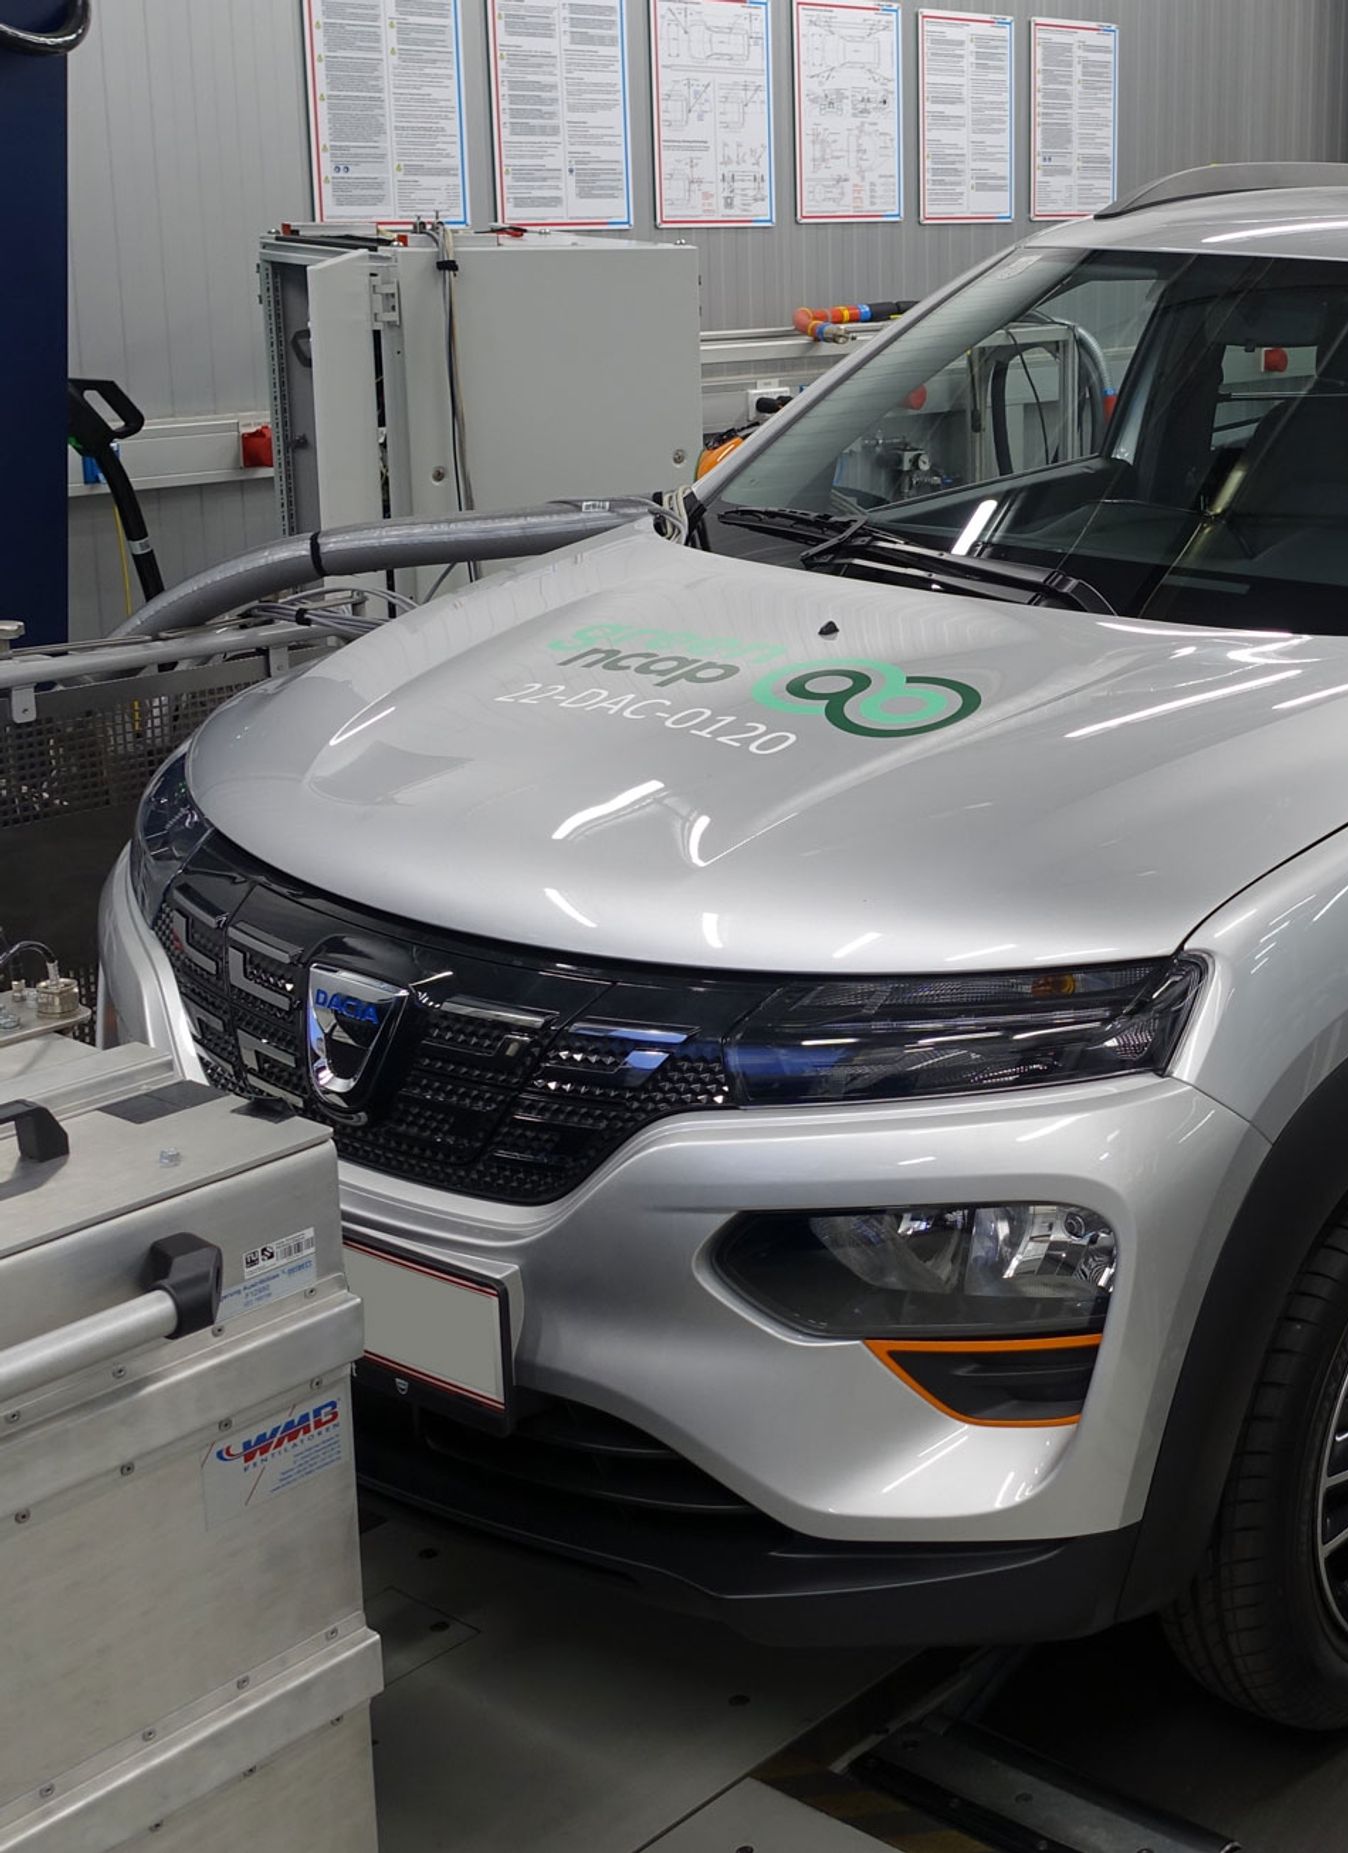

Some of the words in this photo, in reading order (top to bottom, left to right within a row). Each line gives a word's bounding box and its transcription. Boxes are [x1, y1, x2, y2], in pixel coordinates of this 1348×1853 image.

[548, 623, 785, 662] green
[557, 647, 740, 687] ncap
[494, 683, 798, 755] 22-DAC-0120
[315, 989, 379, 1024] DACIA
